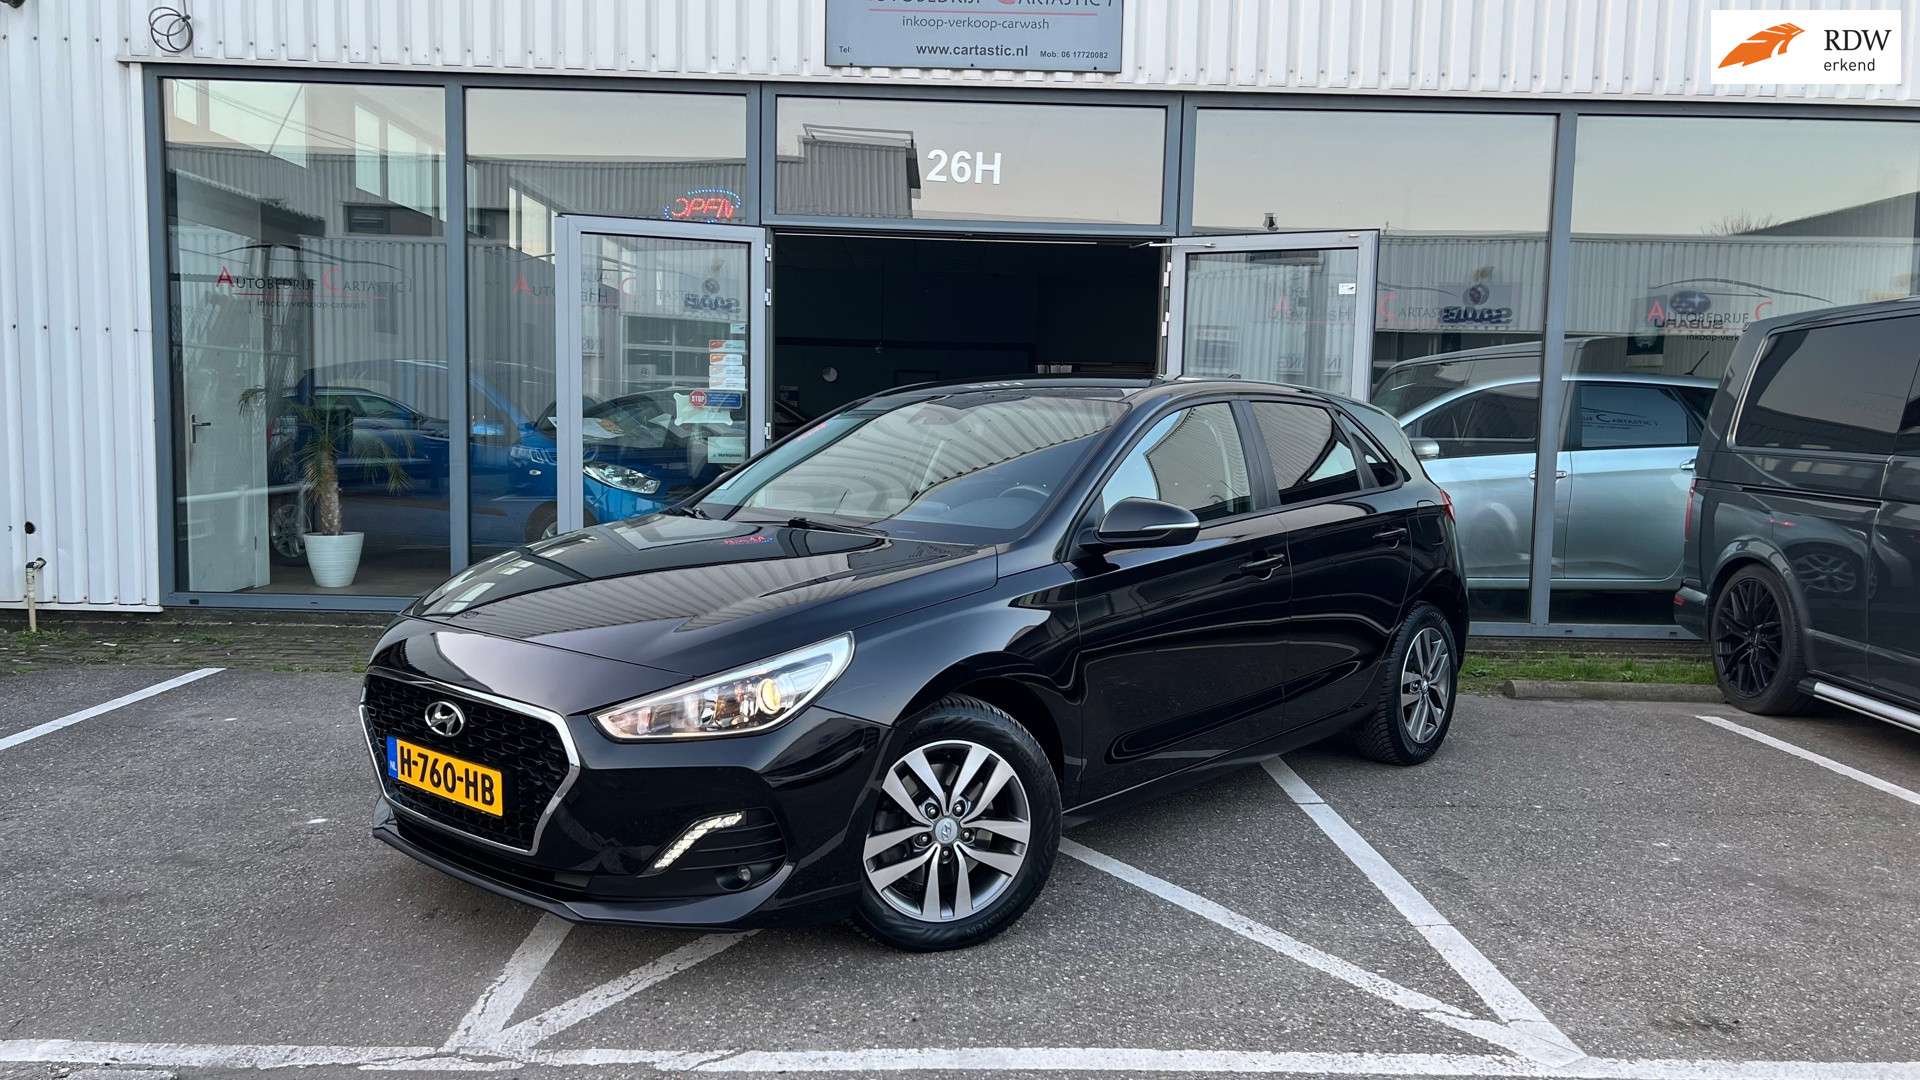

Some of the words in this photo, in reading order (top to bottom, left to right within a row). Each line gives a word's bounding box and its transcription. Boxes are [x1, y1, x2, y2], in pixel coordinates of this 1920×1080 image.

[902, 15, 1050, 31] inkoop-verkoop-carwash
[916, 44, 1028, 57] www.cartastic.nl
[1061, 50, 1071, 58] 06
[926, 149, 1002, 186] 26H
[389, 760, 398, 772] NL
[400, 745, 495, 806] H-760-HB
